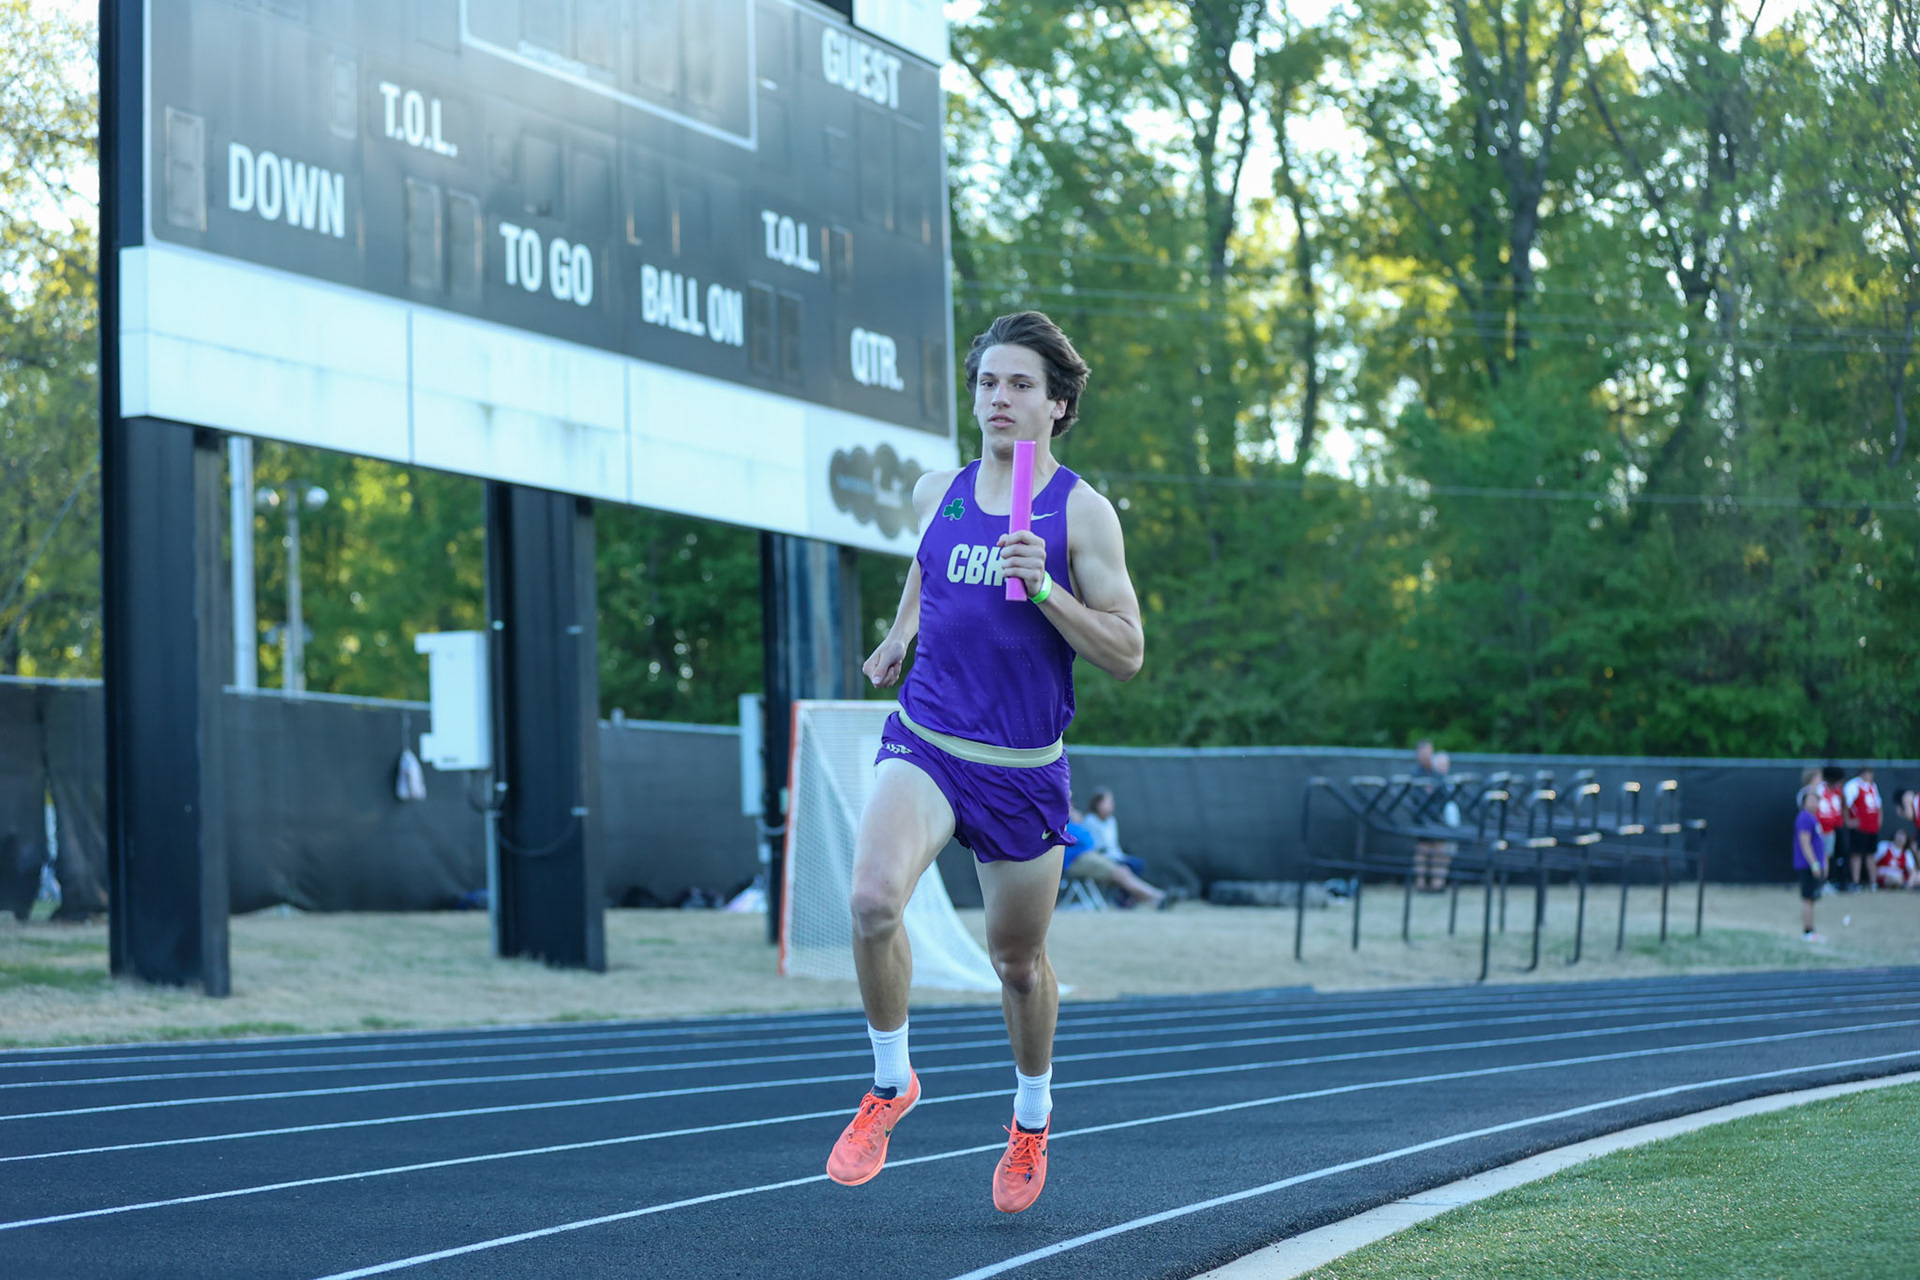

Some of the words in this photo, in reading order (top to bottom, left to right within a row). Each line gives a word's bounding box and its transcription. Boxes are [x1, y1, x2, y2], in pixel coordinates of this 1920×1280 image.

[822, 27, 901, 109] GUEST
[379, 81, 458, 158] T.O.L.
[228, 142, 345, 238] DOWN
[499, 222, 543, 292] TO
[549, 237, 593, 306] GO
[640, 264, 705, 337] BALL
[707, 283, 744, 347] ON
[851, 327, 904, 391] QTR.
[946, 543, 1006, 587] CBH
